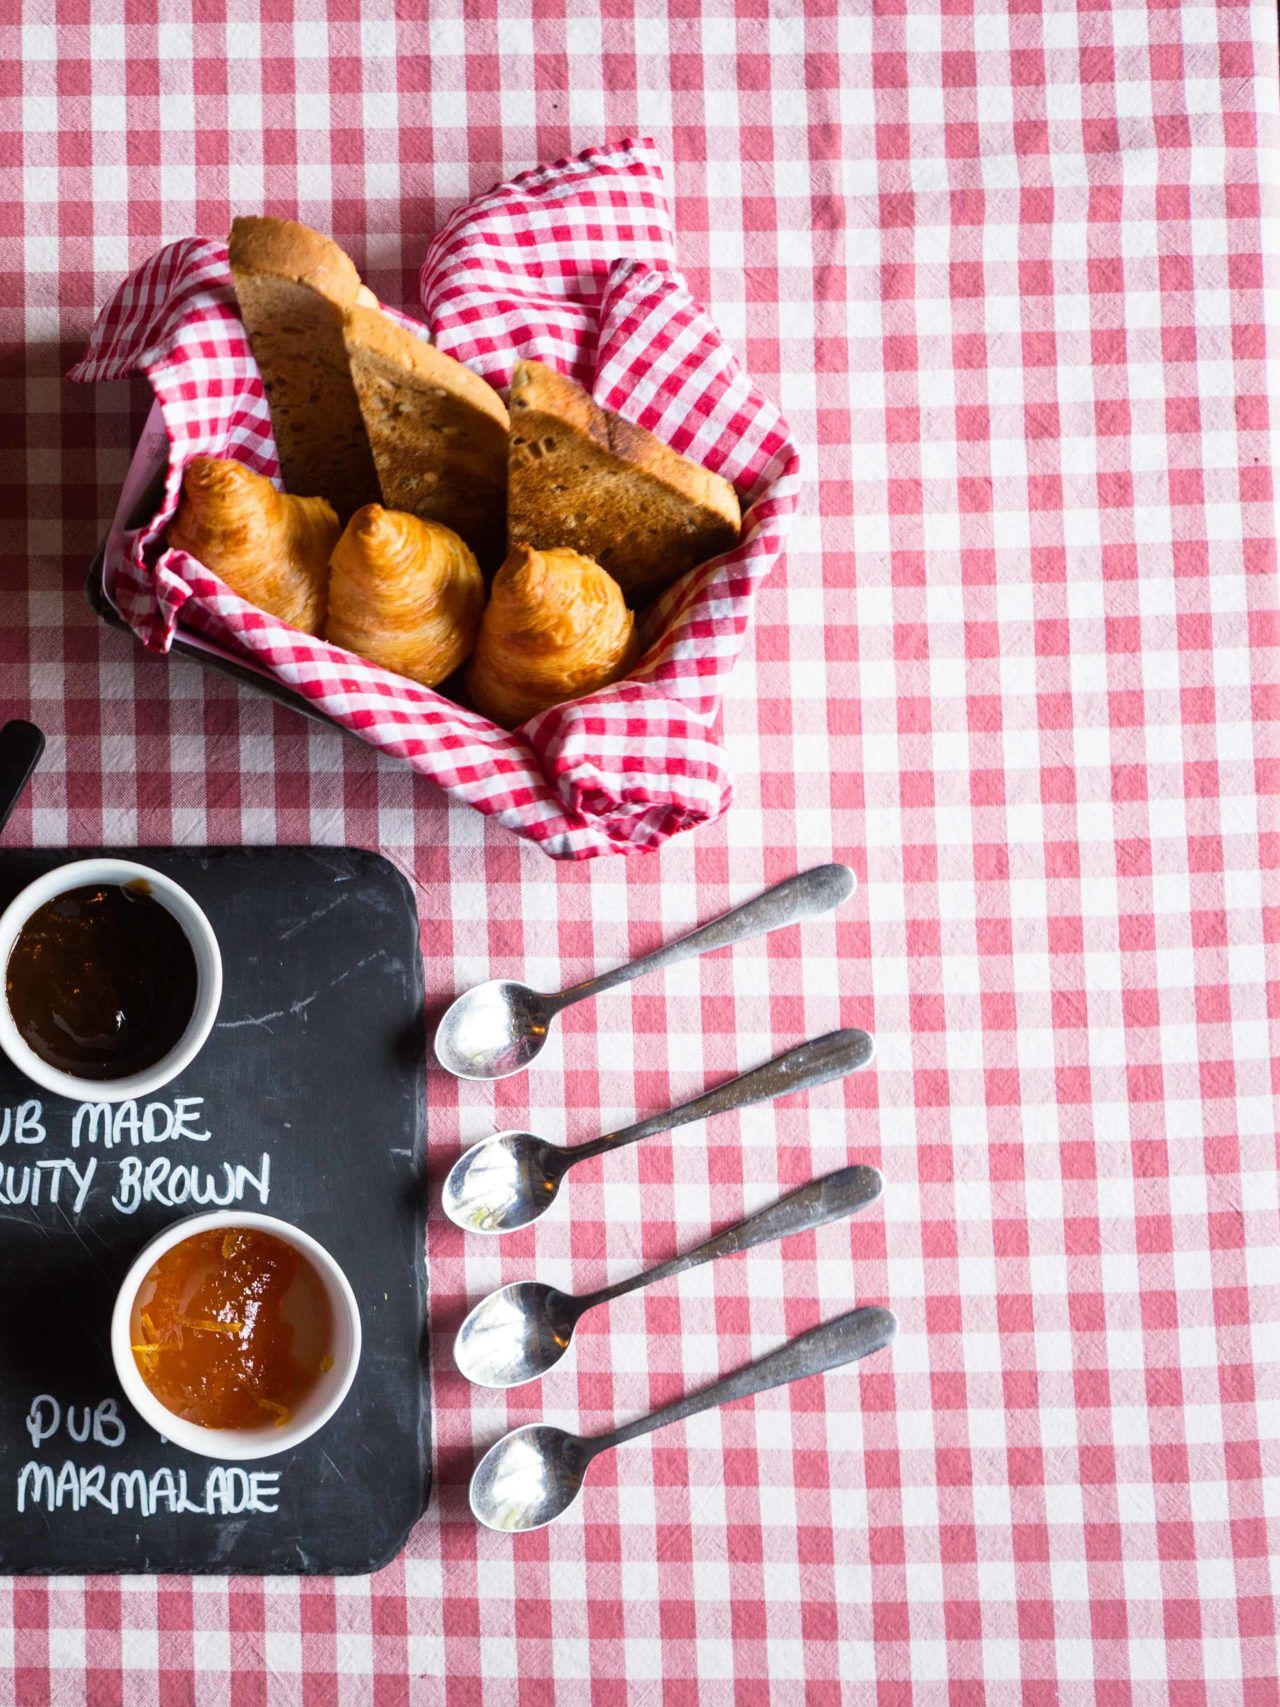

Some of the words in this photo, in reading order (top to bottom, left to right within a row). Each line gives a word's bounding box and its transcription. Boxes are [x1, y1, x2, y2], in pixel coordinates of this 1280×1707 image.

[72, 1097, 212, 1149] MADE
[111, 1152, 270, 1214] BROWN
[26, 1394, 126, 1448] PUB
[17, 1461, 280, 1516] MARMALADE
